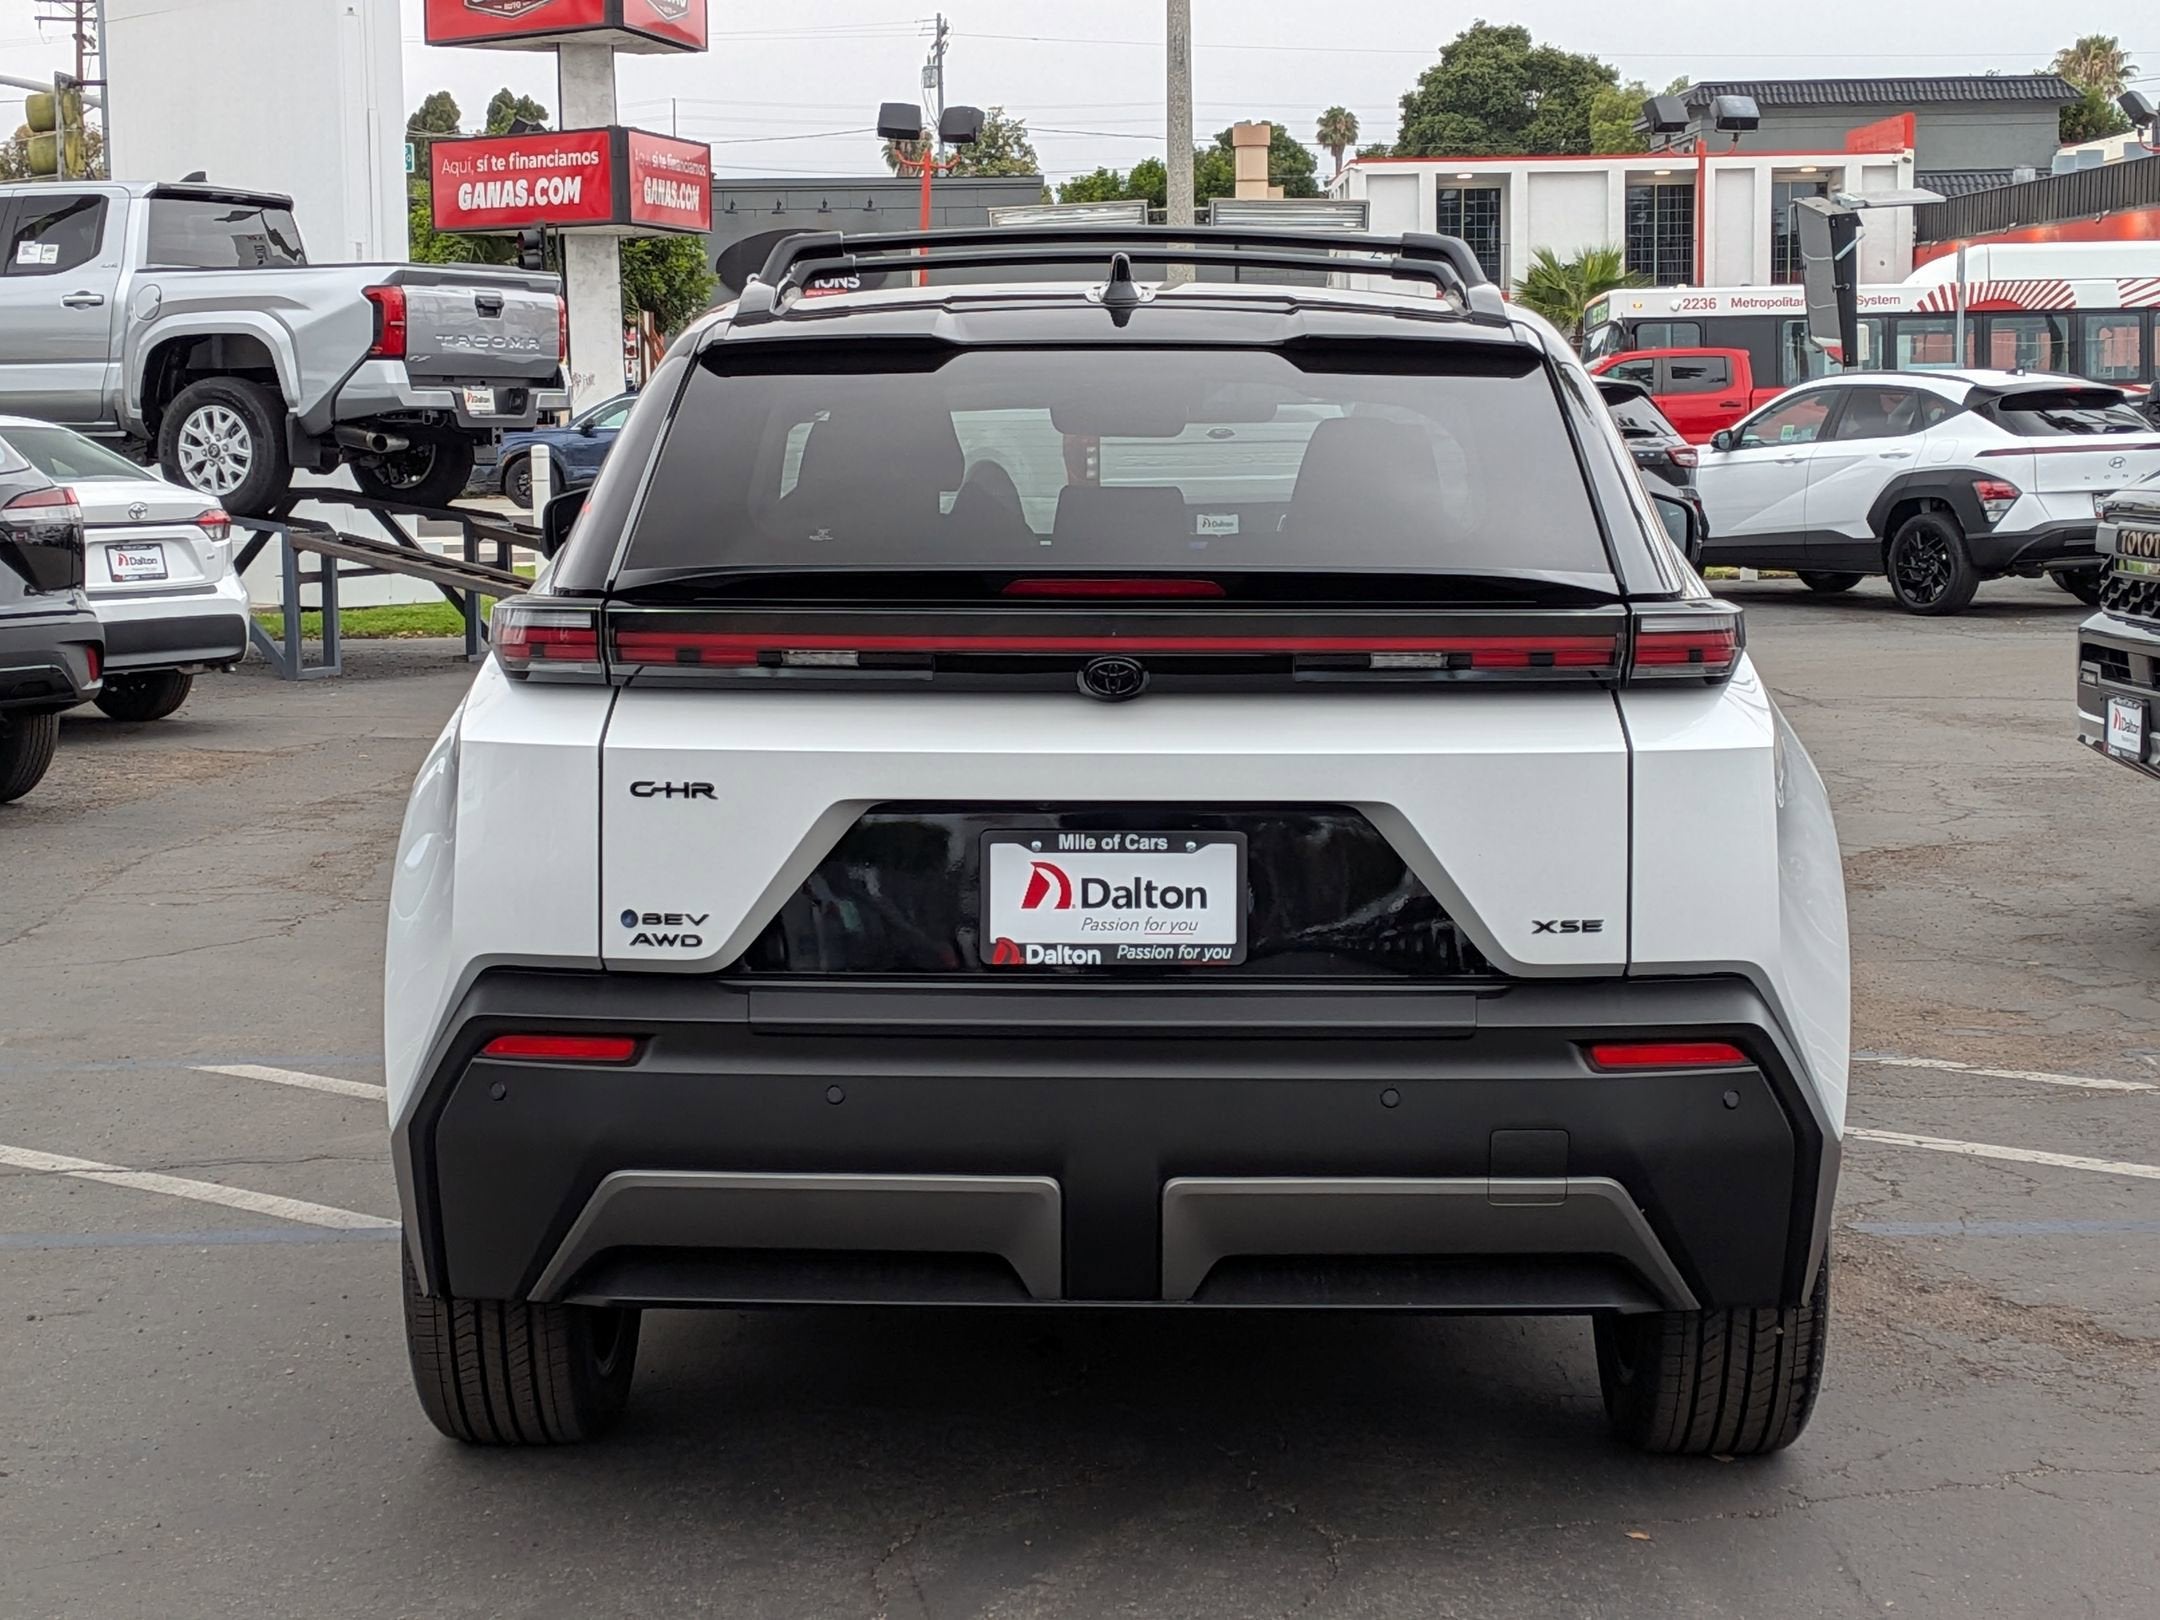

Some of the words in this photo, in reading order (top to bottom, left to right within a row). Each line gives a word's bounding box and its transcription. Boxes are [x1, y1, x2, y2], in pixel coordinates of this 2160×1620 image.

[491, 155, 506, 171] te
[509, 149, 599, 170] financiamos
[458, 176, 582, 211] GANAS.COM
[1683, 297, 1717, 310] 2236
[1856, 295, 1901, 307] System
[435, 333, 540, 350] TACOMA
[129, 556, 157, 566] Dalton
[1058, 834, 1097, 850] Mile
[1102, 834, 1121, 850] of
[1125, 834, 1168, 850] Cars
[1081, 877, 1207, 909] Dalton
[642, 913, 709, 926] BEV
[1081, 917, 1139, 931] Passion
[1144, 916, 1166, 931] for
[1168, 920, 1198, 933] you
[1531, 919, 1605, 934] XSE
[629, 933, 703, 947] AWD
[1026, 944, 1101, 964] Dalton
[1116, 944, 1173, 959] Passion
[1178, 944, 1201, 959] for
[1202, 946, 1232, 962] you
